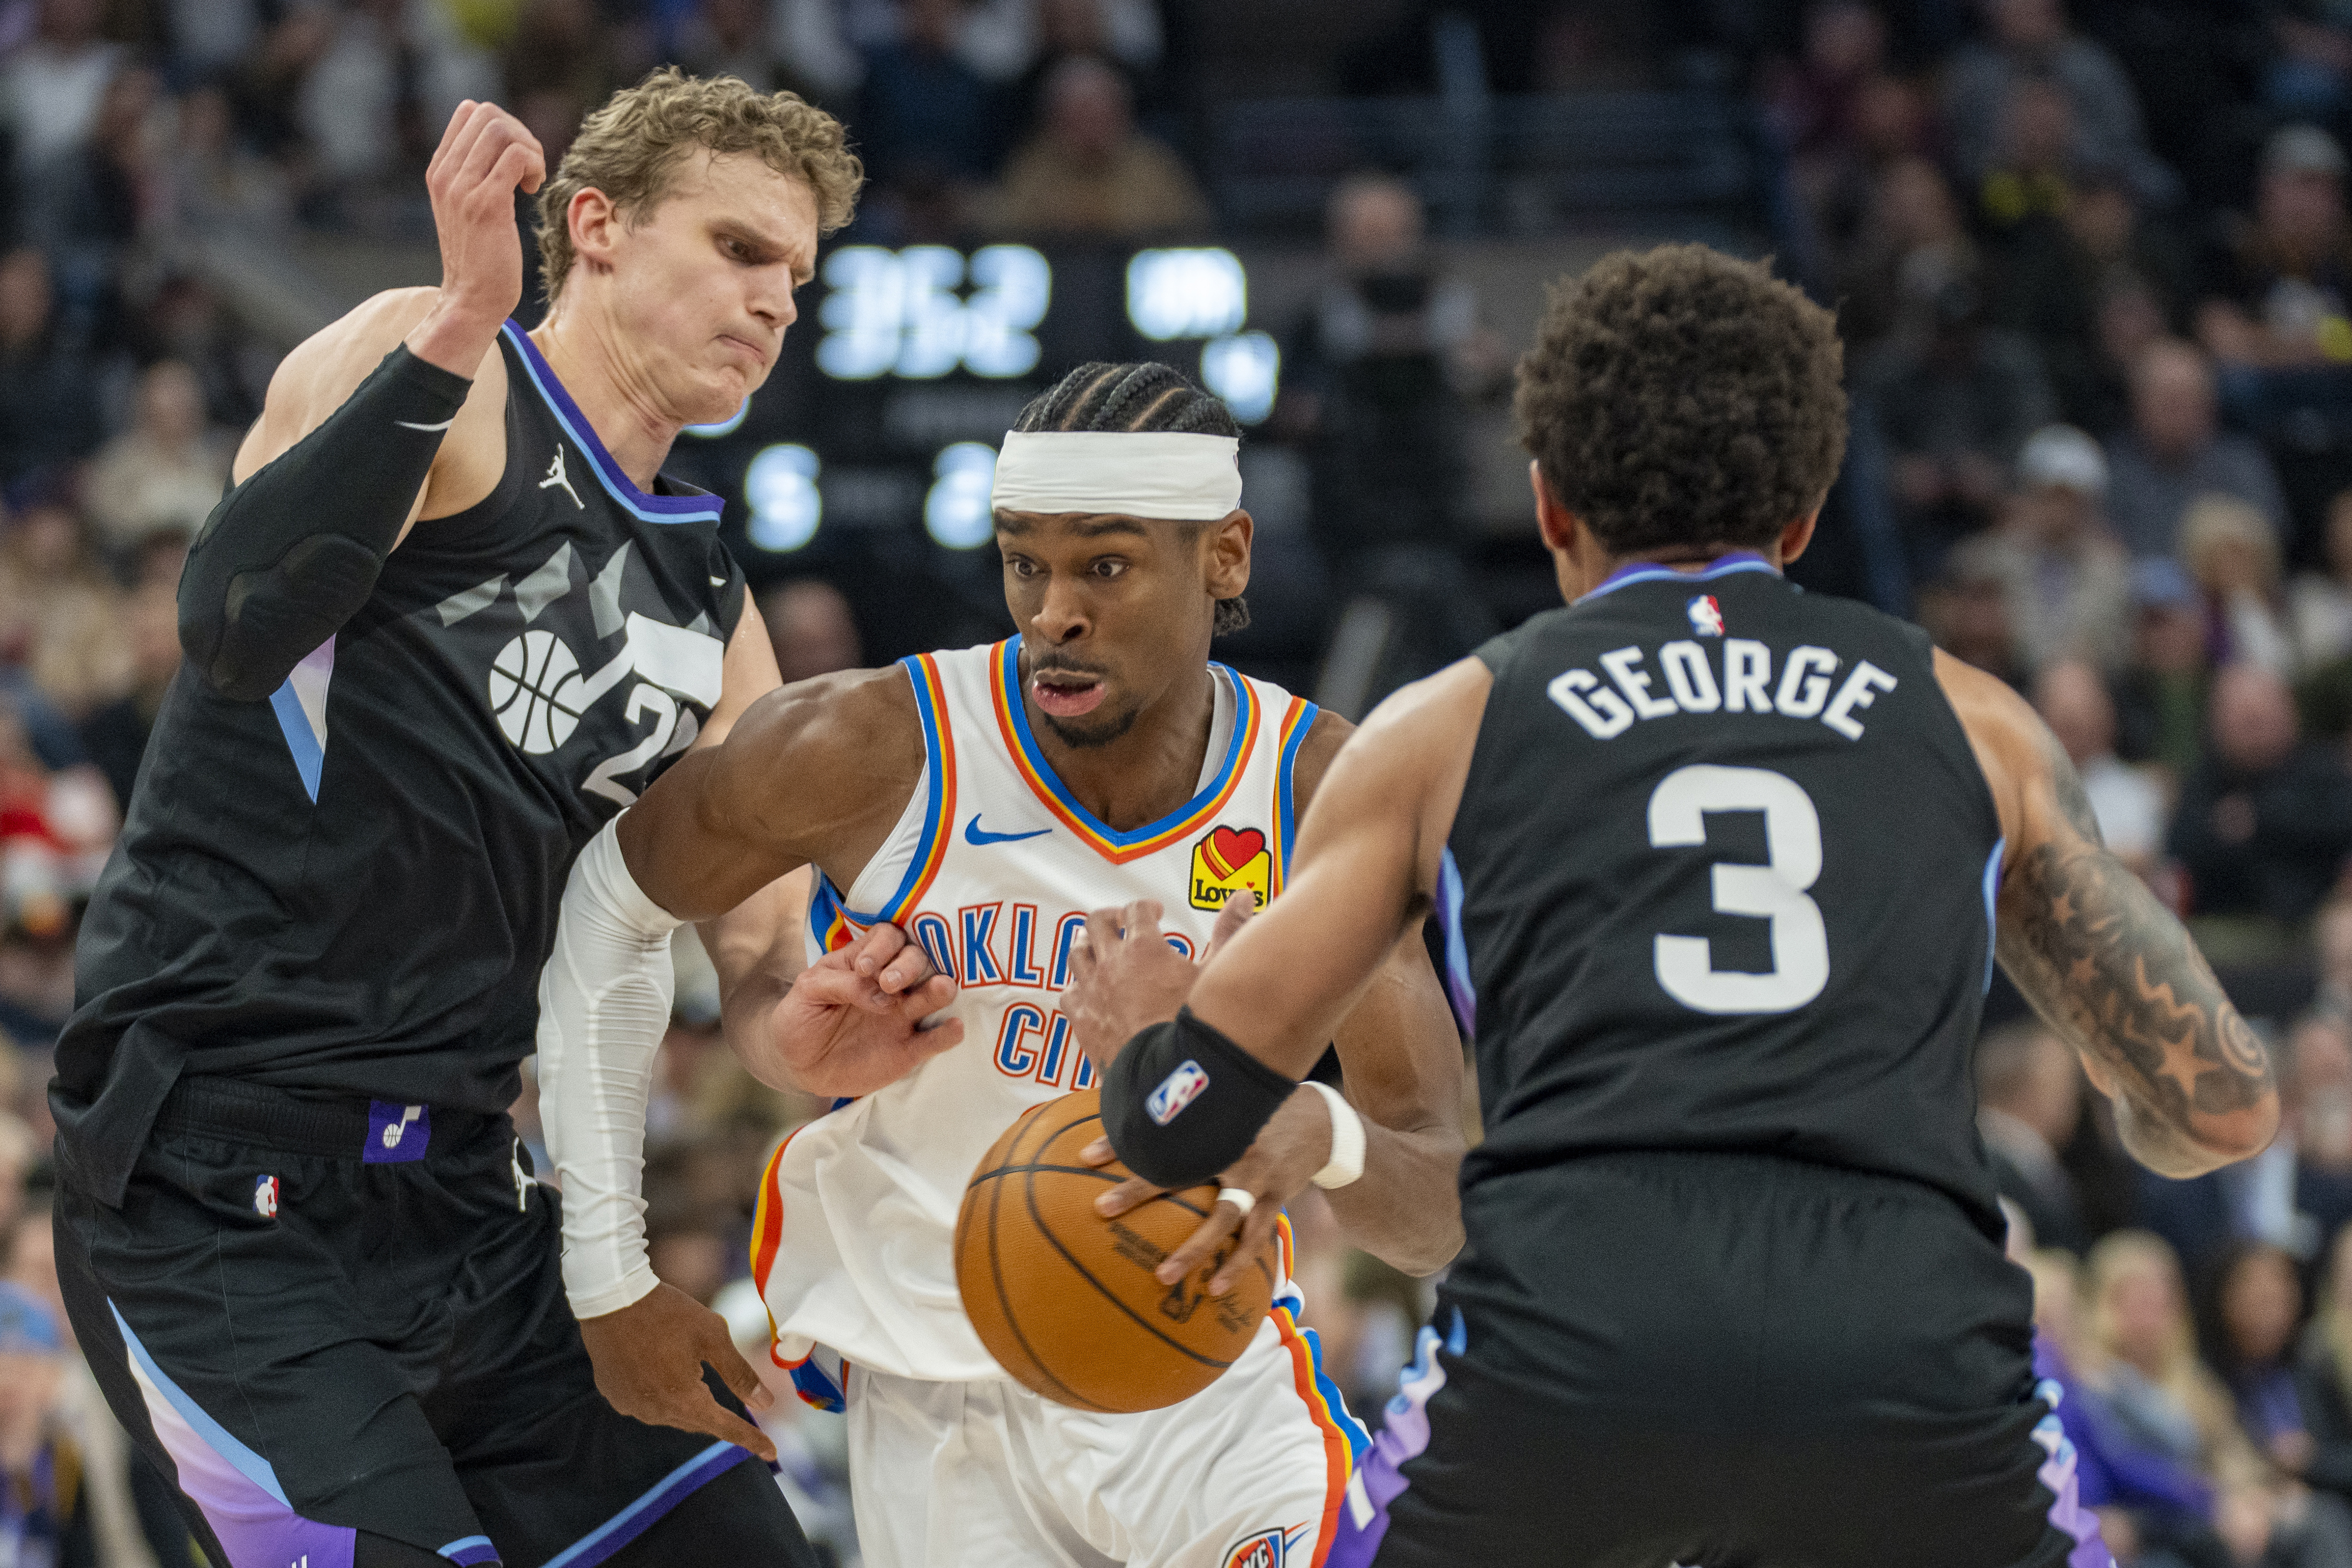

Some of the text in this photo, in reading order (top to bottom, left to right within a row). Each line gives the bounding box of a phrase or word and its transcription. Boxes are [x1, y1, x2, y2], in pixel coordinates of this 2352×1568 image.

[581, 682, 699, 807] 2
[1547, 638, 1898, 742] GEORGE
[1647, 763, 1830, 1014] 3
